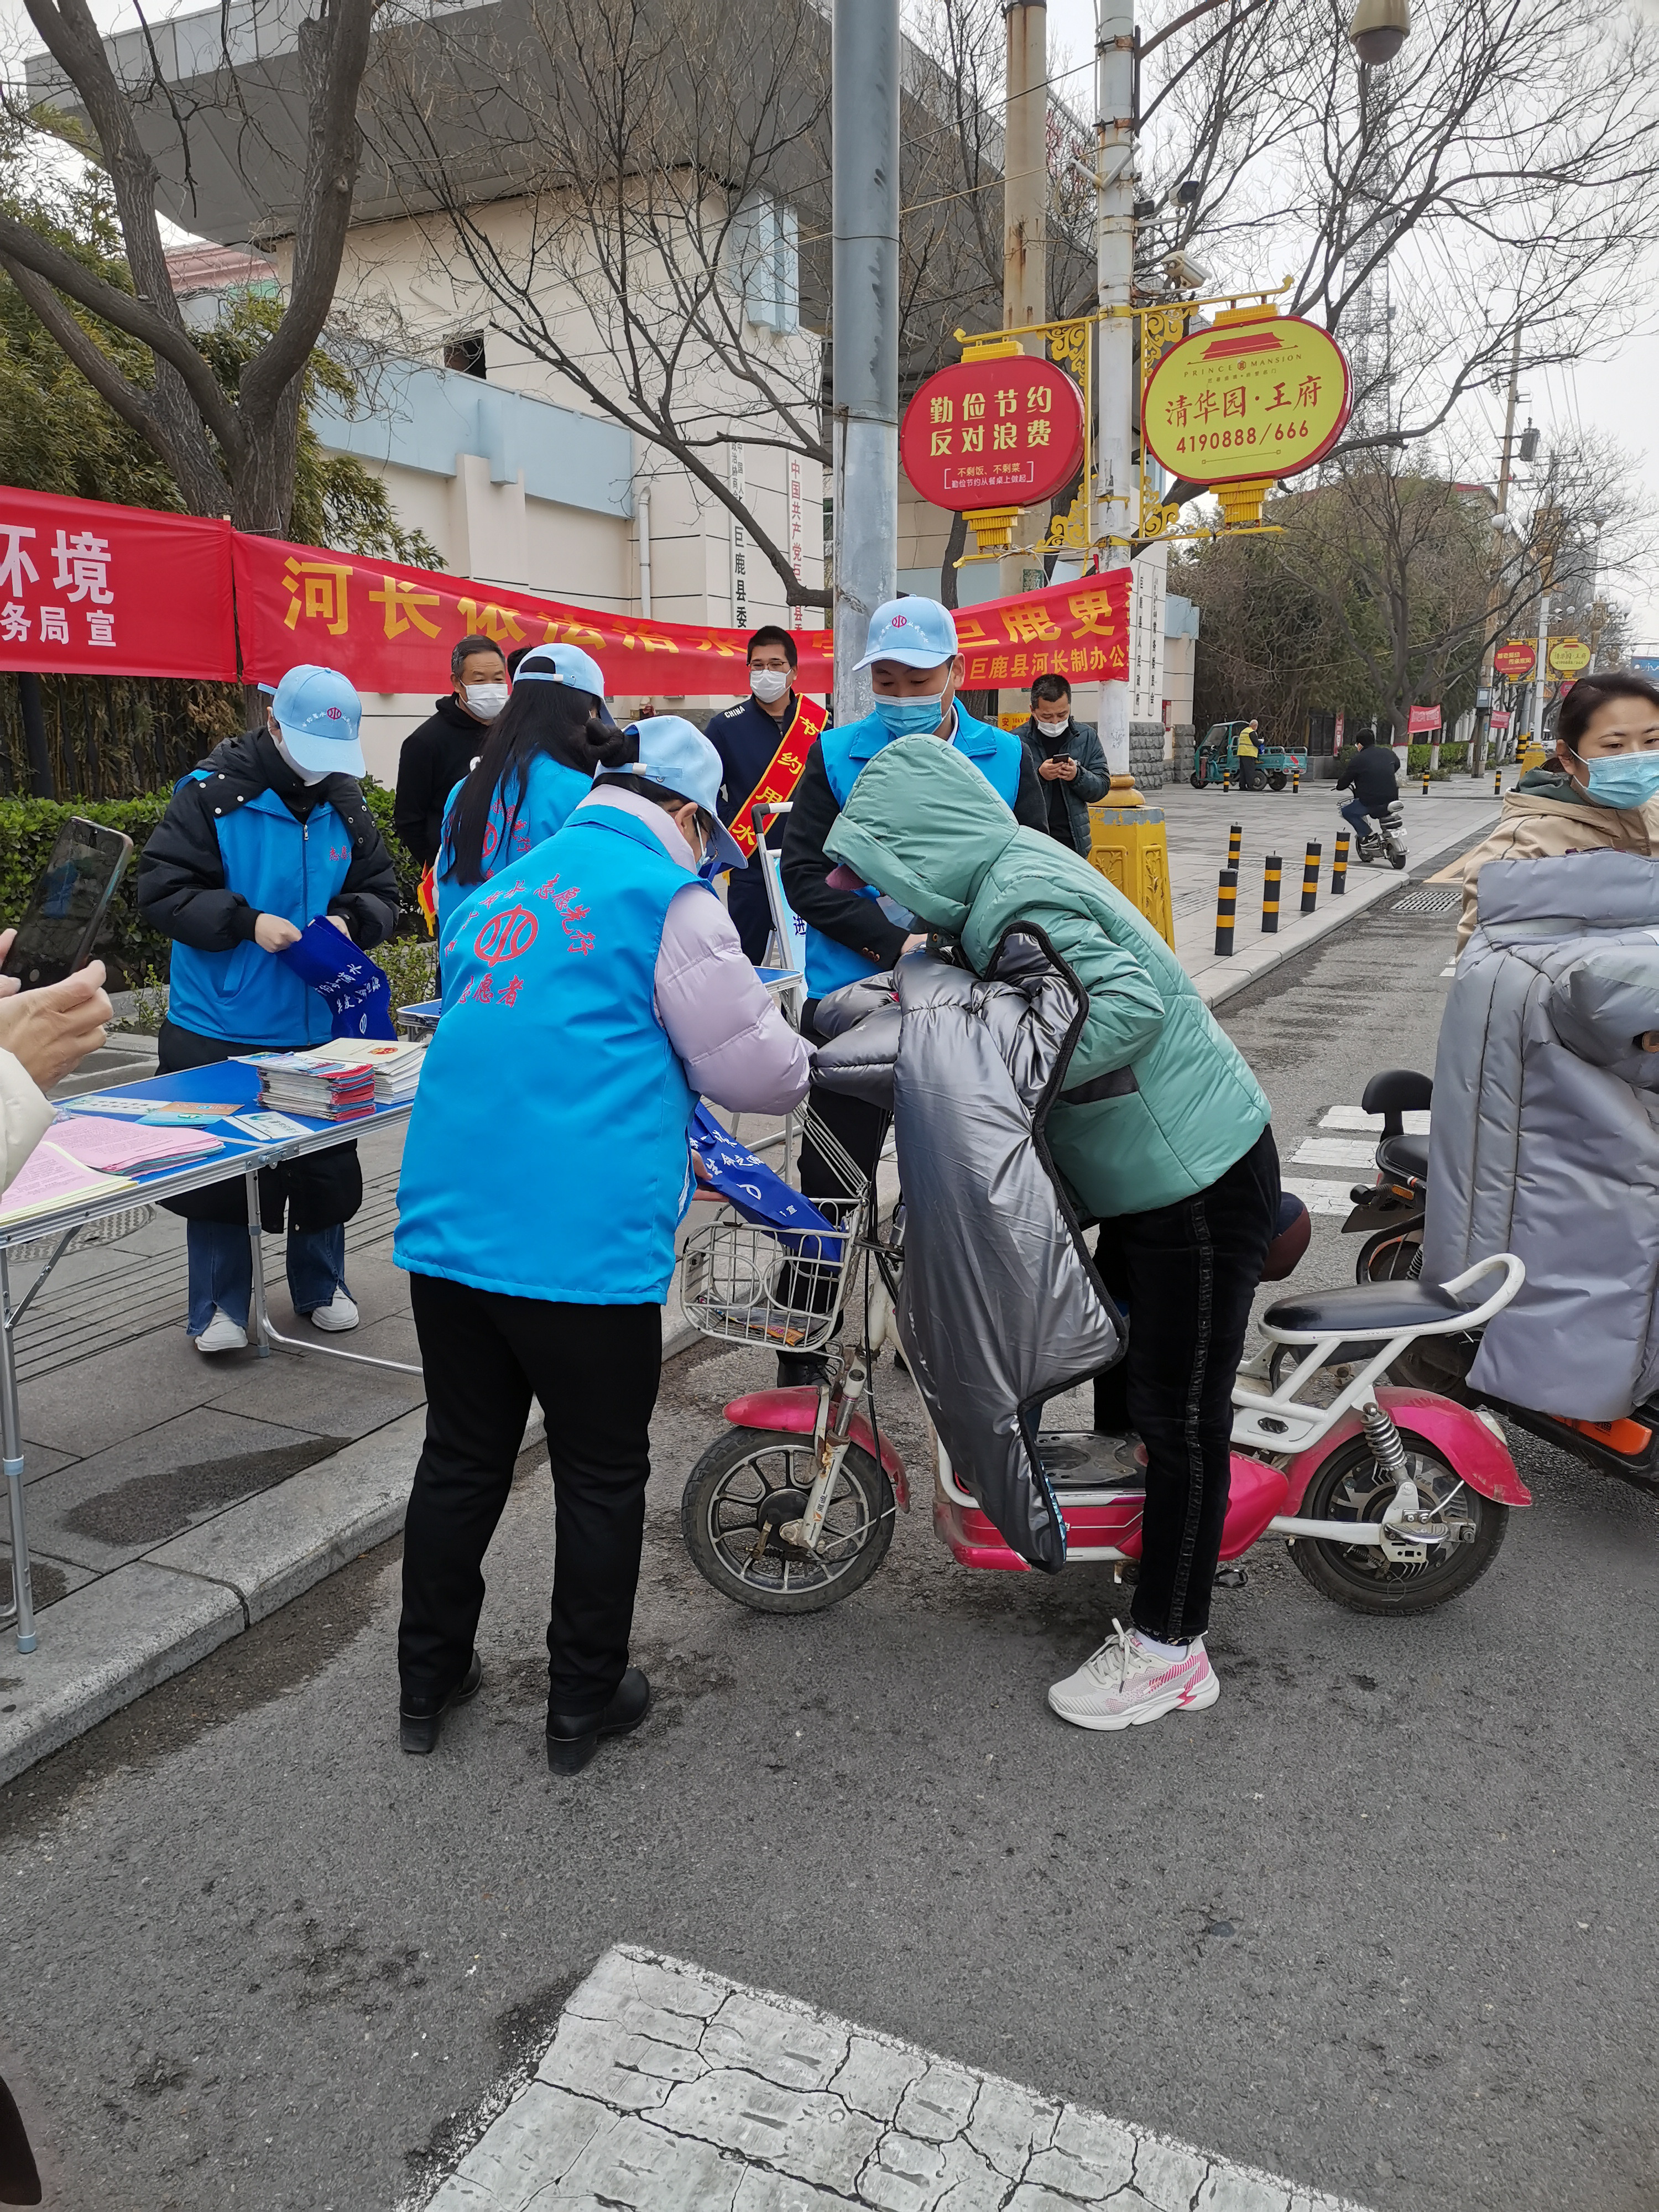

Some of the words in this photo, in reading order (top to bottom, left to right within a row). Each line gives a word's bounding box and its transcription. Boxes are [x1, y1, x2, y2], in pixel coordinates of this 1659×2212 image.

[1184, 364, 1233, 378] PRINCE
[1251, 354, 1302, 367] MANSION
[930, 386, 1051, 424] 勤俭节约
[1165, 375, 1322, 427] 清华园·王府
[930, 419, 1051, 456] 反对浪费
[1176, 420, 1309, 453] 4190888/666
[970, 640, 1130, 680] 巨鹿县河长制办公
[724, 705, 746, 718] CHINA
